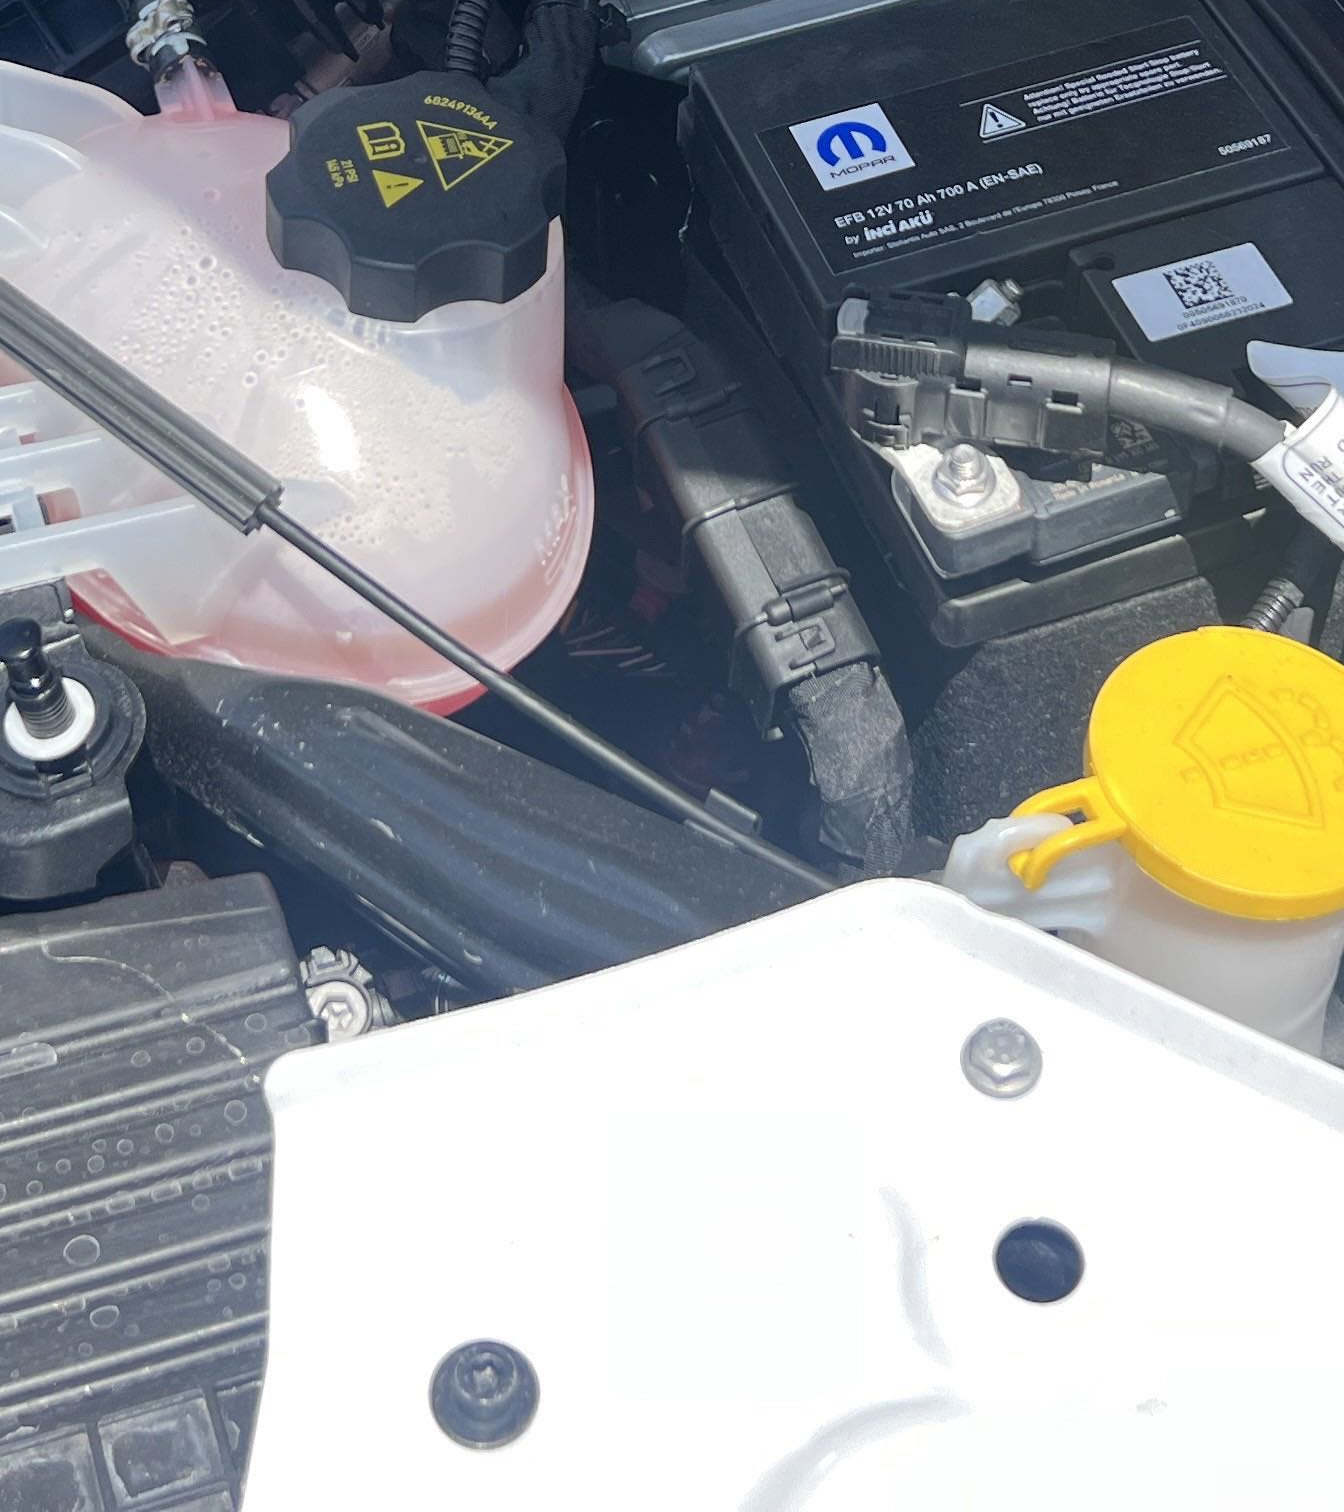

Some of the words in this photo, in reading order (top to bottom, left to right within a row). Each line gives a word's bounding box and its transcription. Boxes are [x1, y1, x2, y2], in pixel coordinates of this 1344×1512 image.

[423, 95, 498, 130] 68249136AA
[829, 155, 896, 178] MOPAR
[834, 211, 866, 228] EFB
[867, 204, 894, 219] 12V
[895, 198, 915, 212] 70
[916, 192, 937, 206] Ah
[936, 184, 965, 200] 700
[967, 180, 979, 192] A
[979, 163, 1044, 190] (EN-SAE)
[844, 234, 860, 246] by
[1298, 455, 1334, 483] RUN
